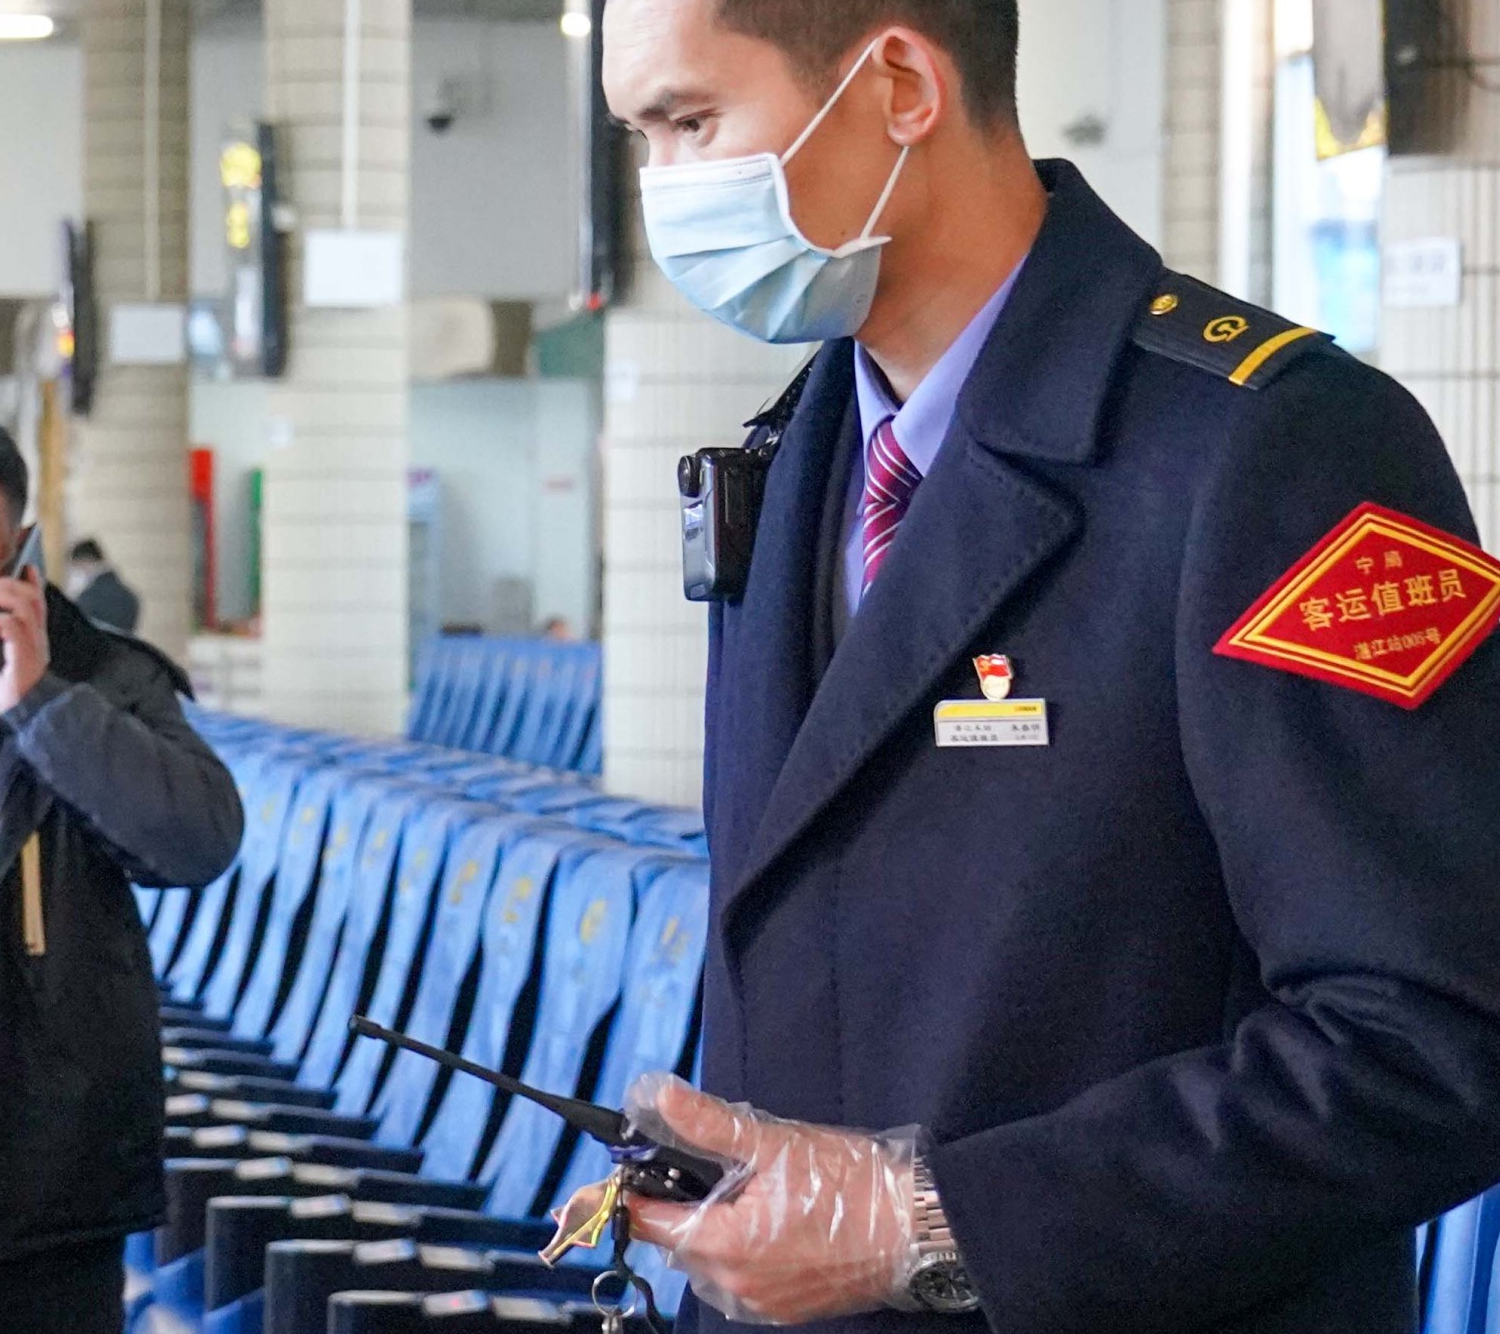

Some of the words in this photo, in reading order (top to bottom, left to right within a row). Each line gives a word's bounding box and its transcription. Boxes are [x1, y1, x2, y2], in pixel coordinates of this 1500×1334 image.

[1298, 568, 1467, 632] 客运值班员
